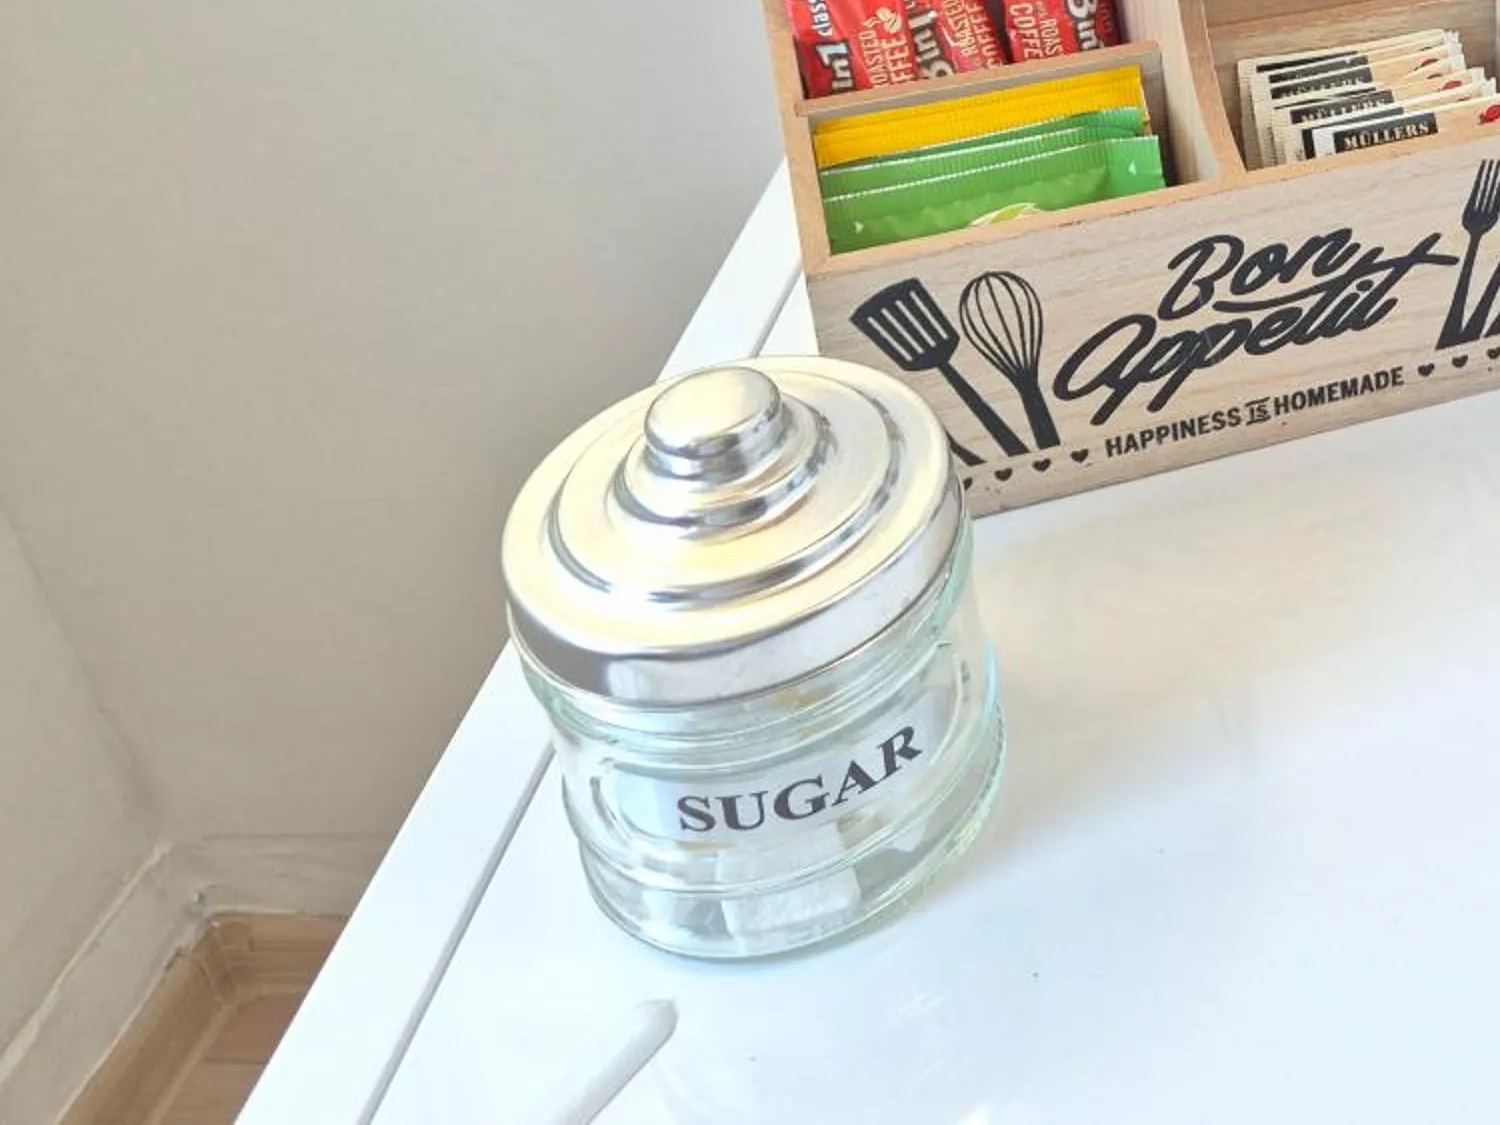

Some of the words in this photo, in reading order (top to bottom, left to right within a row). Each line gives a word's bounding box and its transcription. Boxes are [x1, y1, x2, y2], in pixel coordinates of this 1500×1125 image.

[1009, 2, 1044, 59] COFFE
[1157, 228, 1360, 321] Bon
[1105, 407, 1242, 457] HAPPINESS
[1247, 399, 1270, 424] IS
[1274, 366, 1405, 416] HOMEMADE
[676, 725, 923, 832] SUGAR
